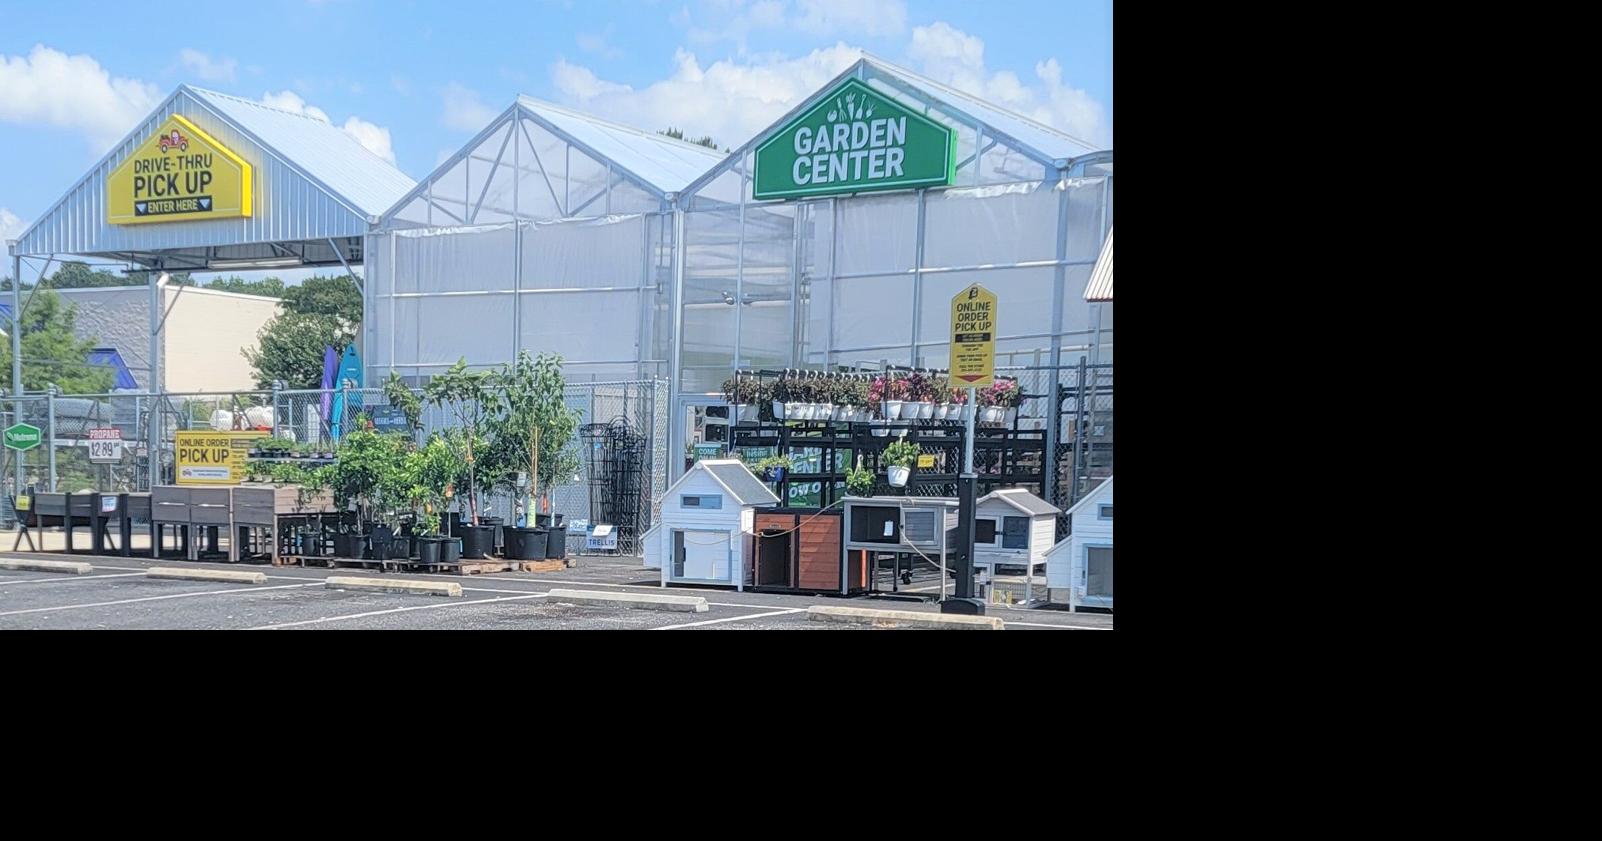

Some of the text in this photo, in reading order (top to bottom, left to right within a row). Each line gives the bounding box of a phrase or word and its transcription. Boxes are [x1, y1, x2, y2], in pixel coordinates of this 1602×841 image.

[793, 116, 907, 155] GARDEN
[134, 153, 213, 174] DRIVE-THRU
[792, 146, 905, 185] CENTER
[133, 170, 213, 198] PICK UP
[147, 199, 198, 214] ENTER HERE
[956, 302, 991, 312] ONLINE
[957, 312, 988, 322] ORDER
[955, 321, 992, 332] PICK UP
[88, 429, 120, 439] PROPANE
[179, 438, 205, 447] ONLINE
[206, 438, 230, 447] ORDER
[179, 448, 209, 463] PICK
[212, 448, 230, 463] UP
[589, 538, 615, 546] TRELLIS
